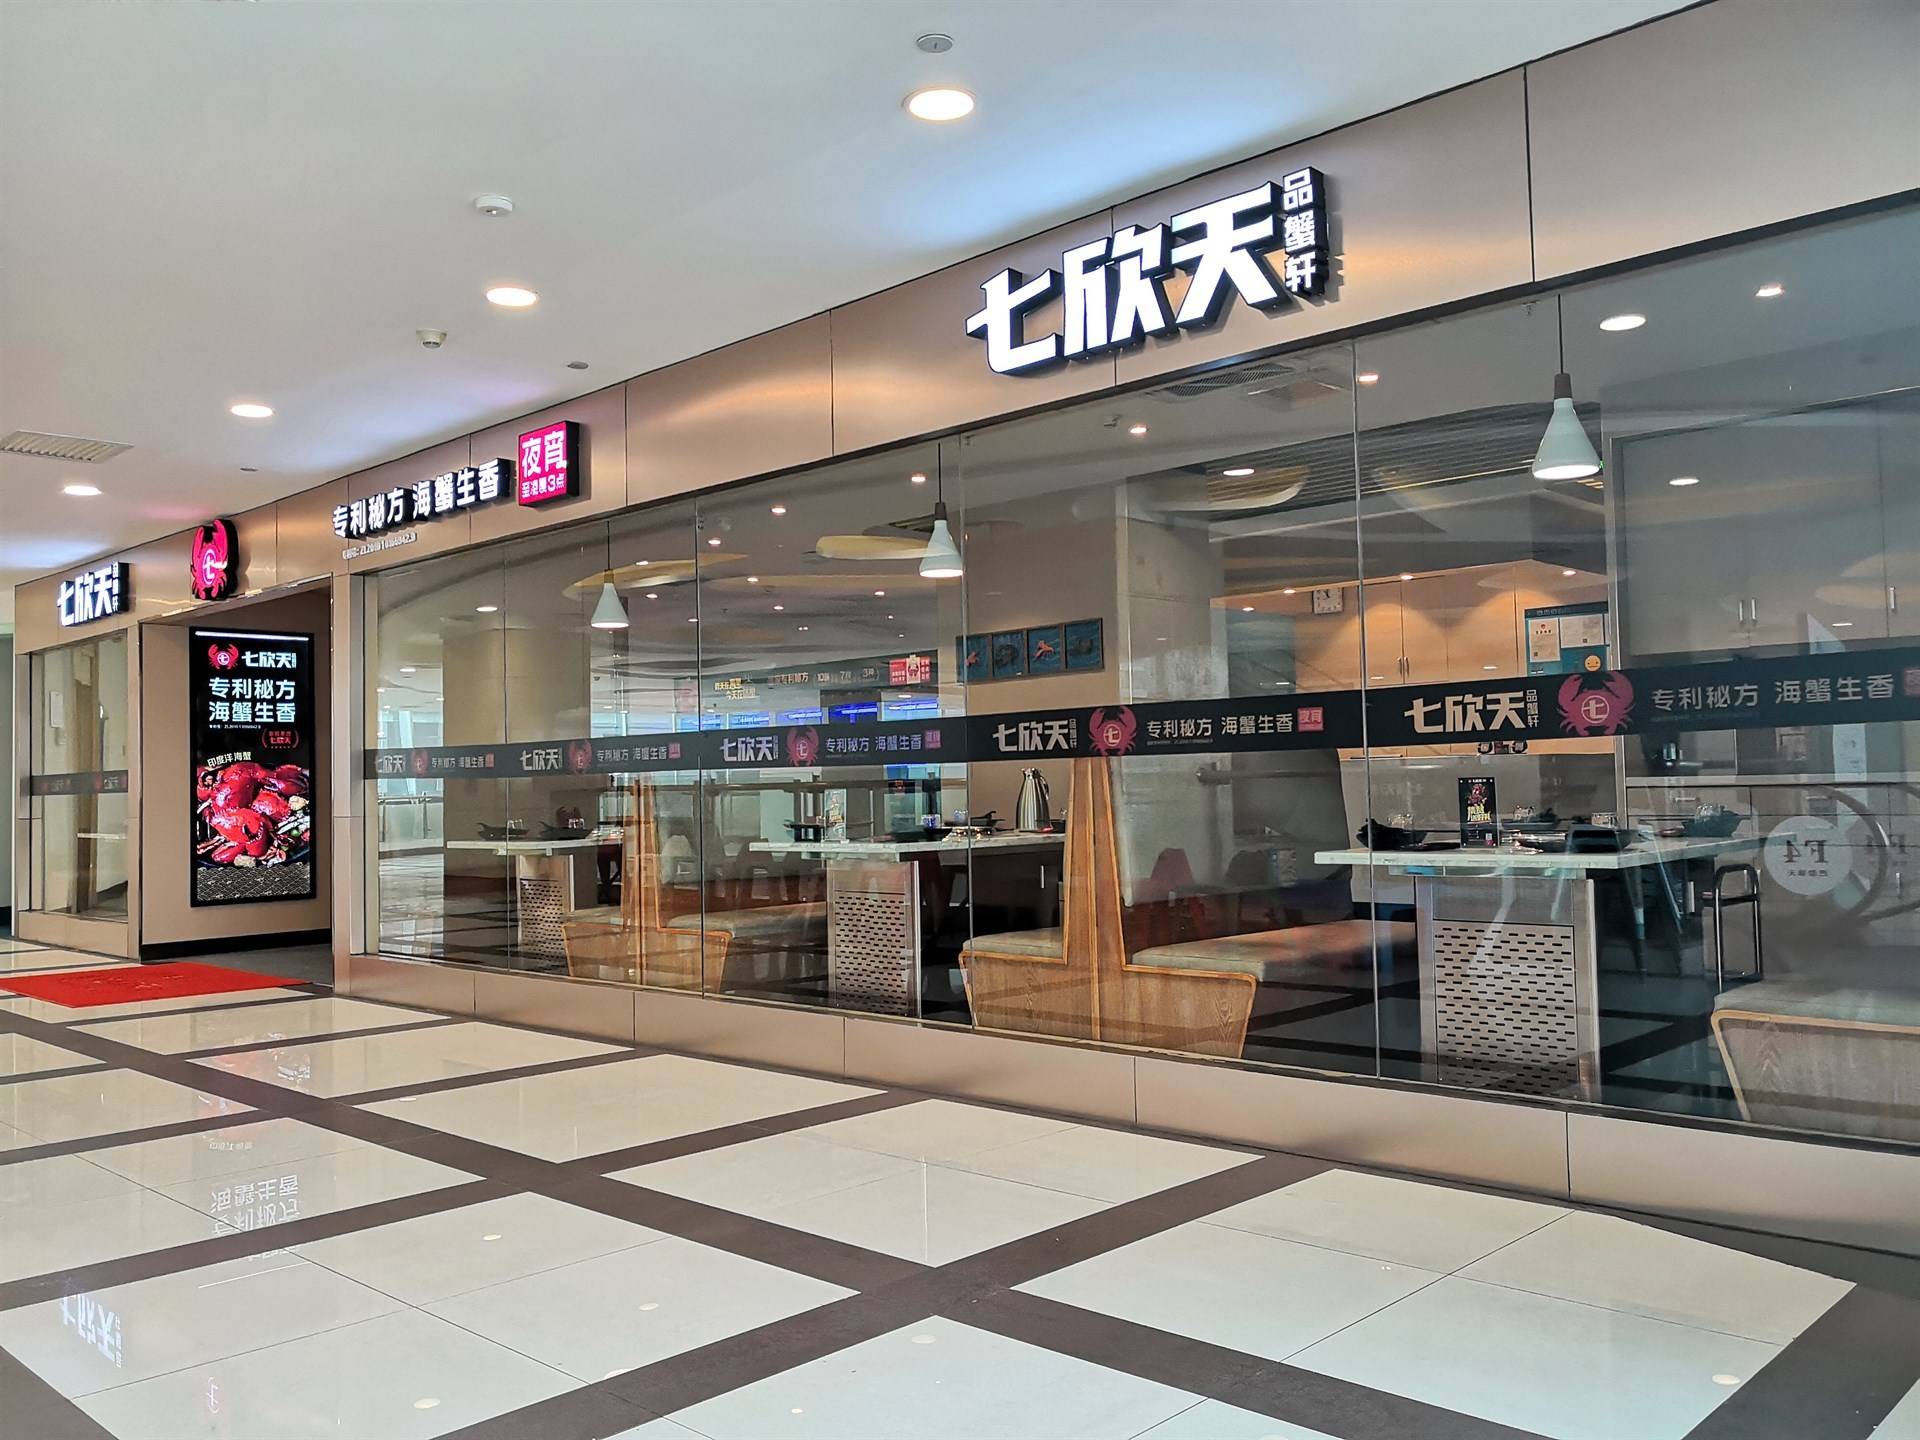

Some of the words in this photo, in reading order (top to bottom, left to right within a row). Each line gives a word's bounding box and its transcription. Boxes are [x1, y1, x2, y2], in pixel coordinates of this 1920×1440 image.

[1282, 167, 1318, 293] 品蟹轩
[965, 181, 1279, 373] 七欣天
[521, 430, 567, 478] 夜宵
[332, 487, 405, 538] 专利秘方
[411, 458, 499, 520] 海蟹生香
[57, 564, 112, 626] 七欣天
[241, 651, 292, 668] 七欣天
[208, 677, 296, 700] 专利秘方
[1652, 683, 1760, 712] 专利秘方
[1774, 673, 1896, 705] 海蟹生香
[208, 701, 296, 723] 海蟹生香
[1146, 718, 1213, 738] 专利秘方
[1221, 713, 1294, 735] 海蟹生香
[1404, 690, 1527, 734] 七欣天
[720, 736, 773, 762] 七欣天
[825, 737, 870, 753] 专利秘方
[874, 735, 922, 752] 海蟹生香
[992, 719, 1069, 752] 七欣天
[519, 748, 559, 771] 七欣天
